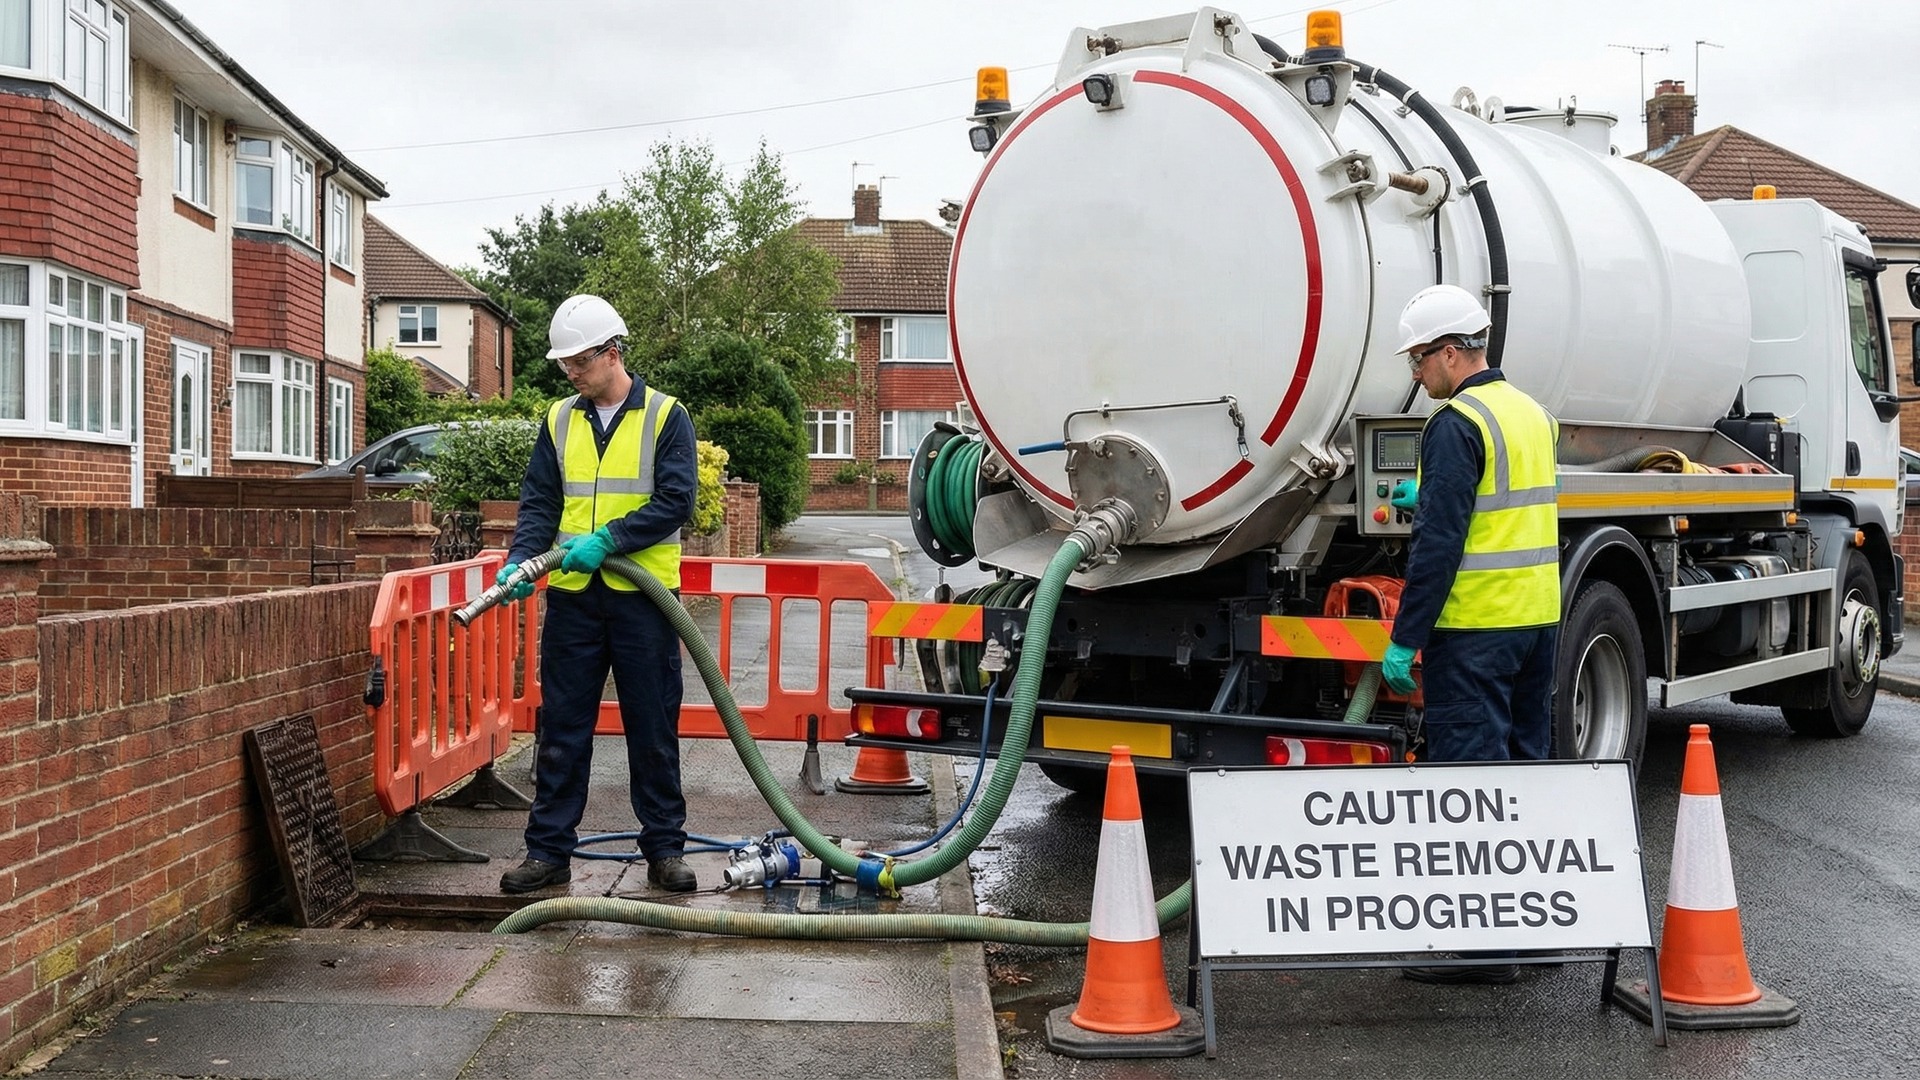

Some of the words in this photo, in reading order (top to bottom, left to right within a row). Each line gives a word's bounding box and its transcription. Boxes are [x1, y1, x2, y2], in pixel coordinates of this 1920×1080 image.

[1303, 788, 1519, 826] CAUTION:
[1219, 843, 1380, 880] WASTE
[1393, 838, 1614, 877] REMOVAL
[1266, 897, 1310, 933] IN
[1326, 890, 1578, 931] PROGRESS
